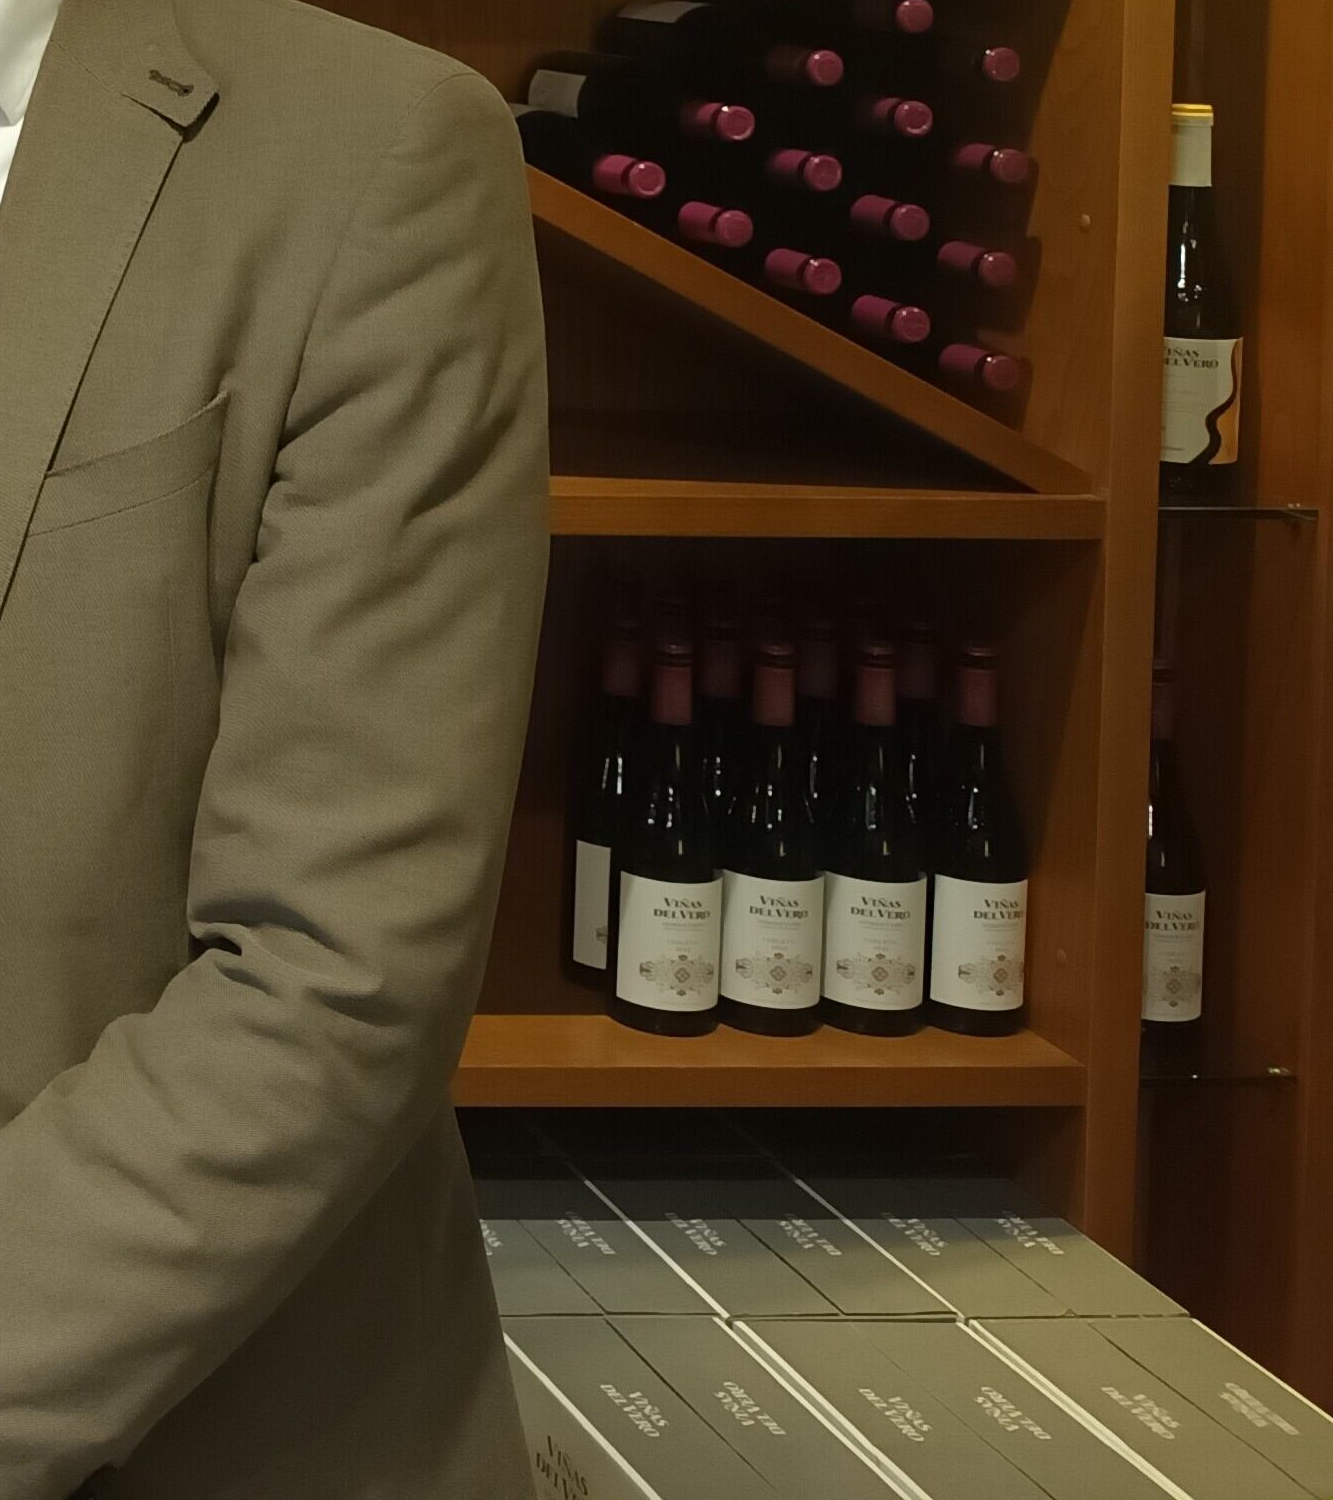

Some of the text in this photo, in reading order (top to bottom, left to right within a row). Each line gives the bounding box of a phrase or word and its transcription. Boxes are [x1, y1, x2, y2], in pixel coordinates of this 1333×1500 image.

[663, 896, 703, 909] VIÑAS
[759, 894, 799, 908] VIÑAS
[861, 896, 901, 908] VIÑAS
[601, 1384, 661, 1438] DEL VERO
[629, 1391, 669, 1426] VIÑAS
[713, 1391, 755, 1426] VIÑAS
[723, 1381, 761, 1413] VERO
[884, 1410, 925, 1442] VERO
[889, 1396, 932, 1432] VIÑAS
